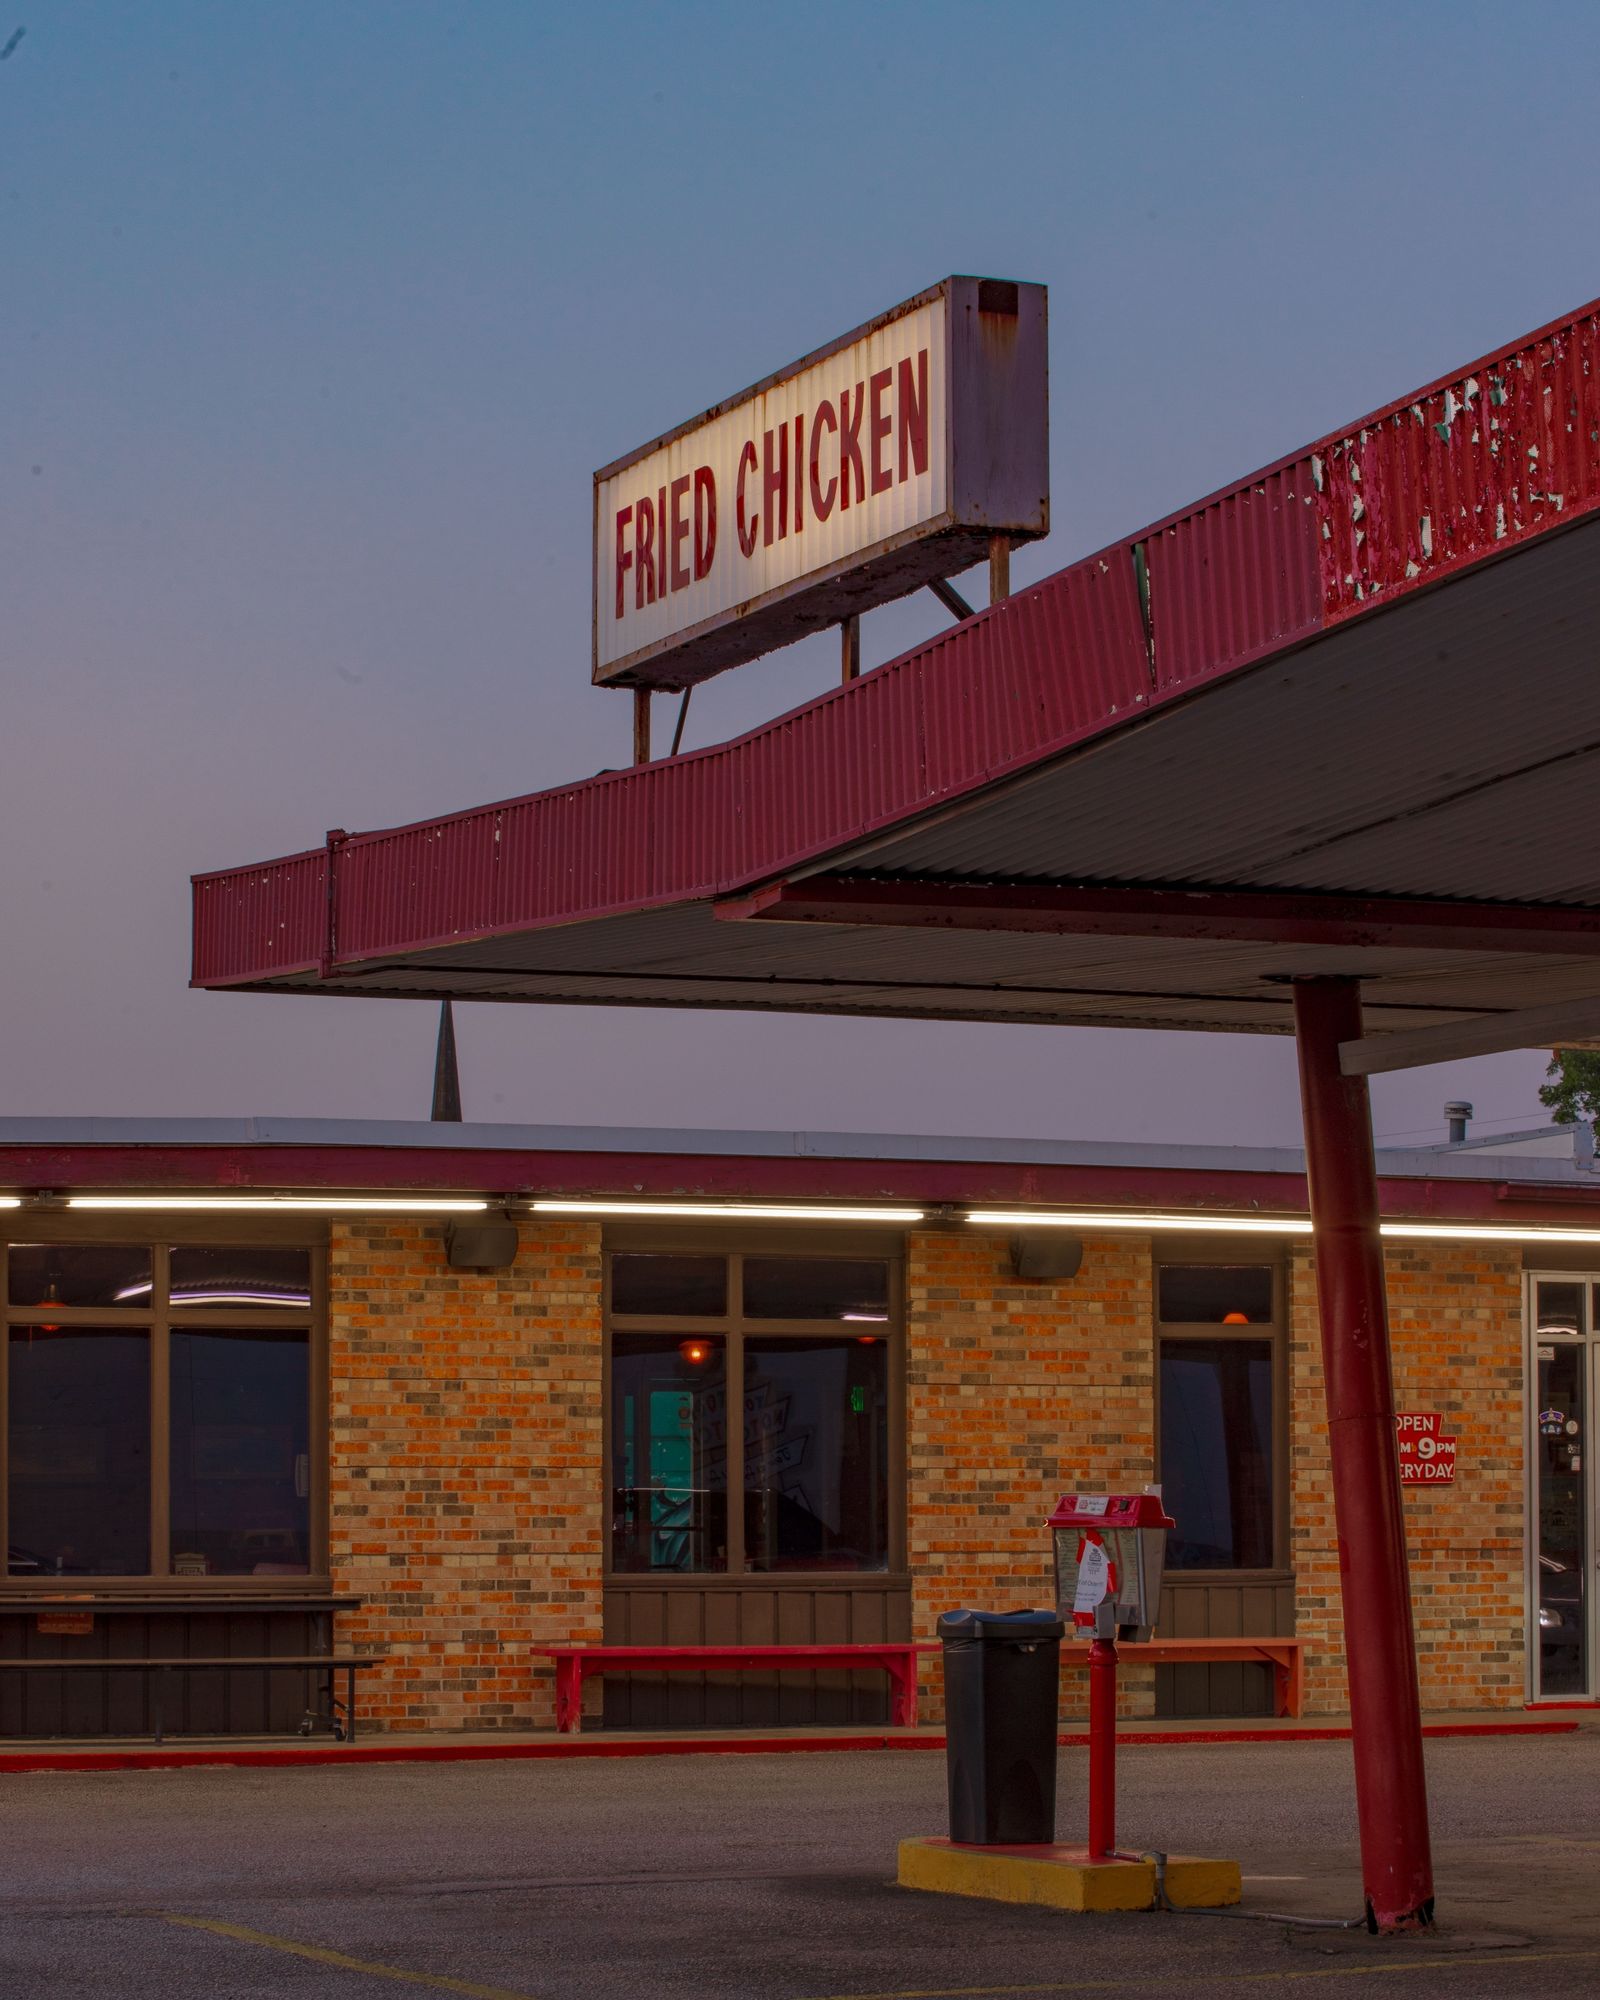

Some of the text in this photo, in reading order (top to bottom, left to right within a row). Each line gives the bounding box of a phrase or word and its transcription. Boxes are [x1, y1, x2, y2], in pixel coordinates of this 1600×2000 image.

[615, 348, 928, 620] FRIED CHICKEN
[1400, 1441, 1411, 1453] M
